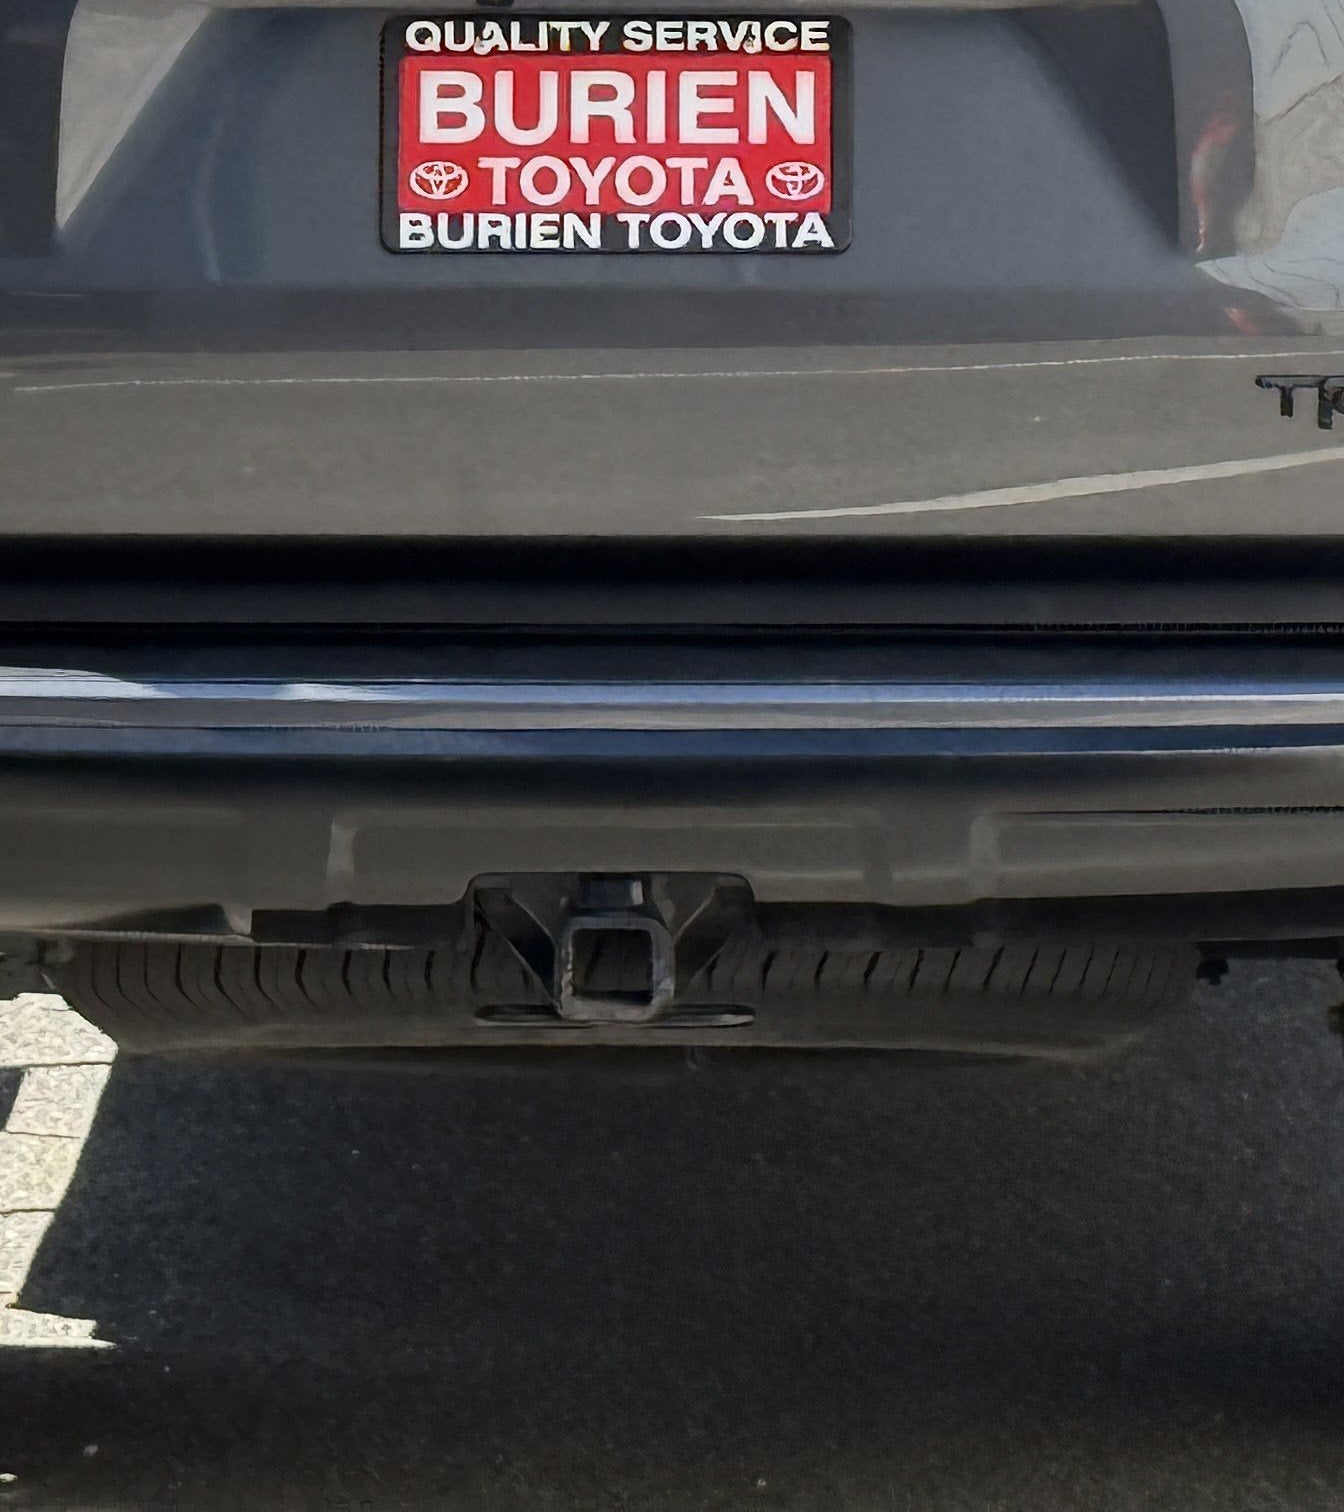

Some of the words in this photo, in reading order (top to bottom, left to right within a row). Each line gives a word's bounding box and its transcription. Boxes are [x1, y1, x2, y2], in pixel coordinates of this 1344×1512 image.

[405, 20, 610, 55] QUALITY
[623, 20, 830, 54] SERVICE
[418, 70, 816, 146] BURIEN
[477, 155, 756, 207] TOYOTA
[399, 212, 602, 250] BURIEN
[617, 212, 835, 249] TOYOTA
